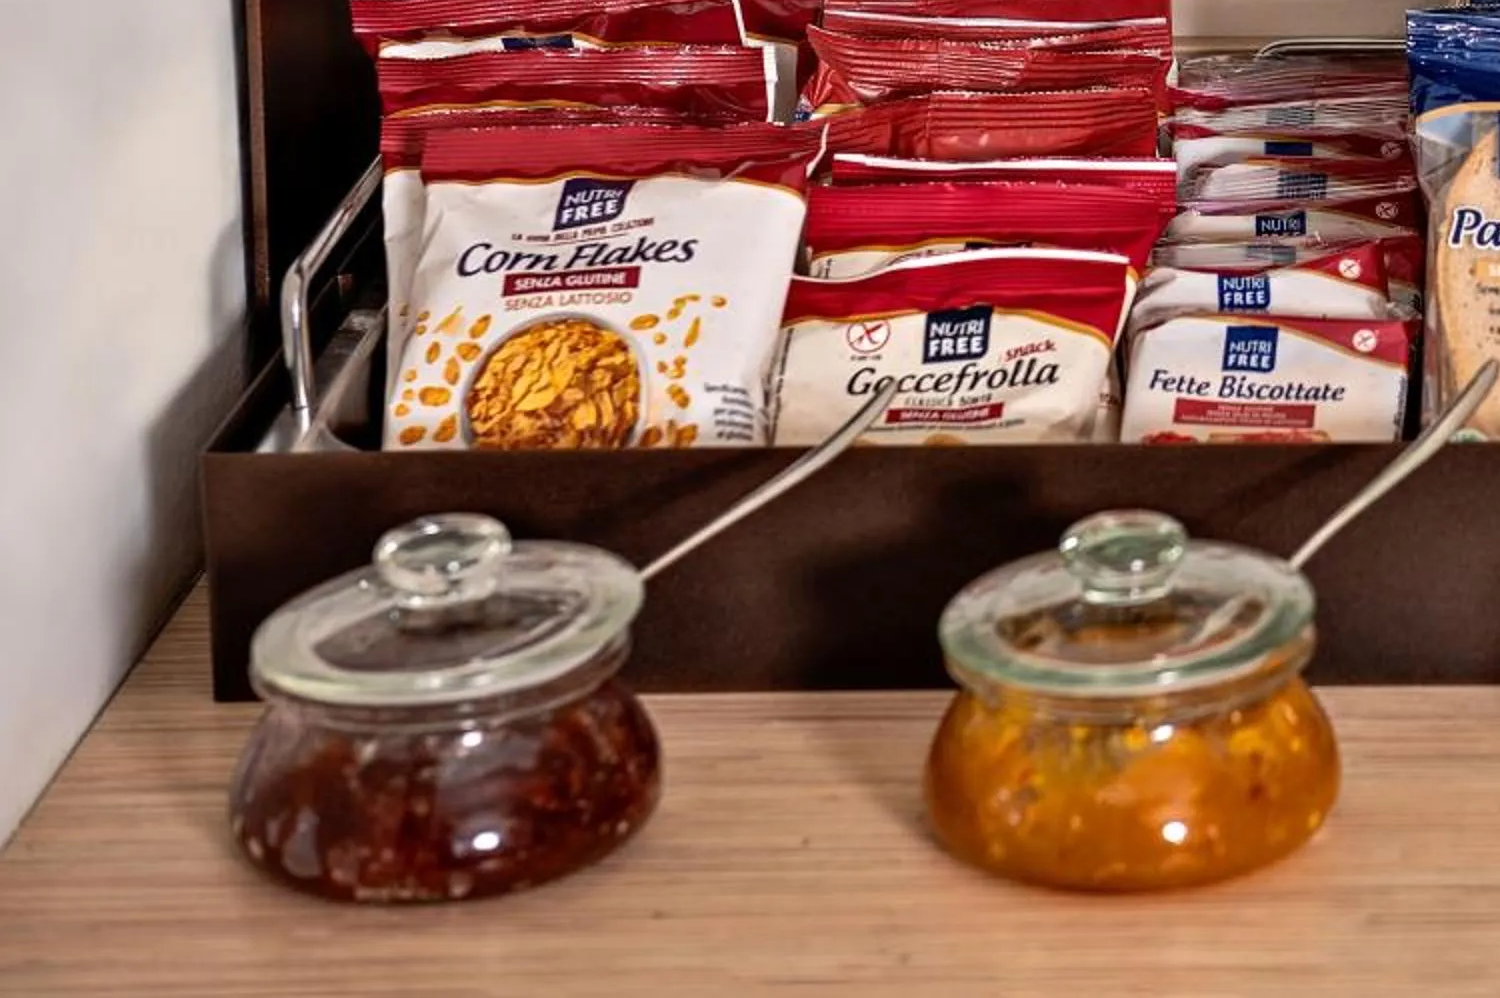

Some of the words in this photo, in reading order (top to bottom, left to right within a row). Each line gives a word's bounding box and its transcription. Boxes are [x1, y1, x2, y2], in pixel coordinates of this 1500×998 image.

[564, 189, 625, 207] NUTRI
[561, 200, 618, 223] FREE
[1261, 218, 1301, 231] NUTRI
[457, 243, 557, 277] Corn
[564, 236, 699, 269] Flakes
[514, 275, 562, 290] SENZA
[565, 272, 626, 288] GLUTINE
[1223, 277, 1265, 290] NUTRI
[505, 297, 554, 311] SENZA
[560, 291, 633, 306] LATTOSIO
[1223, 291, 1265, 305] FREE
[929, 319, 985, 338] NUTRI
[928, 336, 984, 357] FREE
[1005, 339, 1057, 362] snack
[1229, 339, 1272, 354] NUTRI
[1227, 353, 1271, 369] FREE
[847, 358, 1060, 395] Goccefrolla
[1149, 369, 1211, 397] Fette
[1217, 375, 1346, 402] Biscottate
